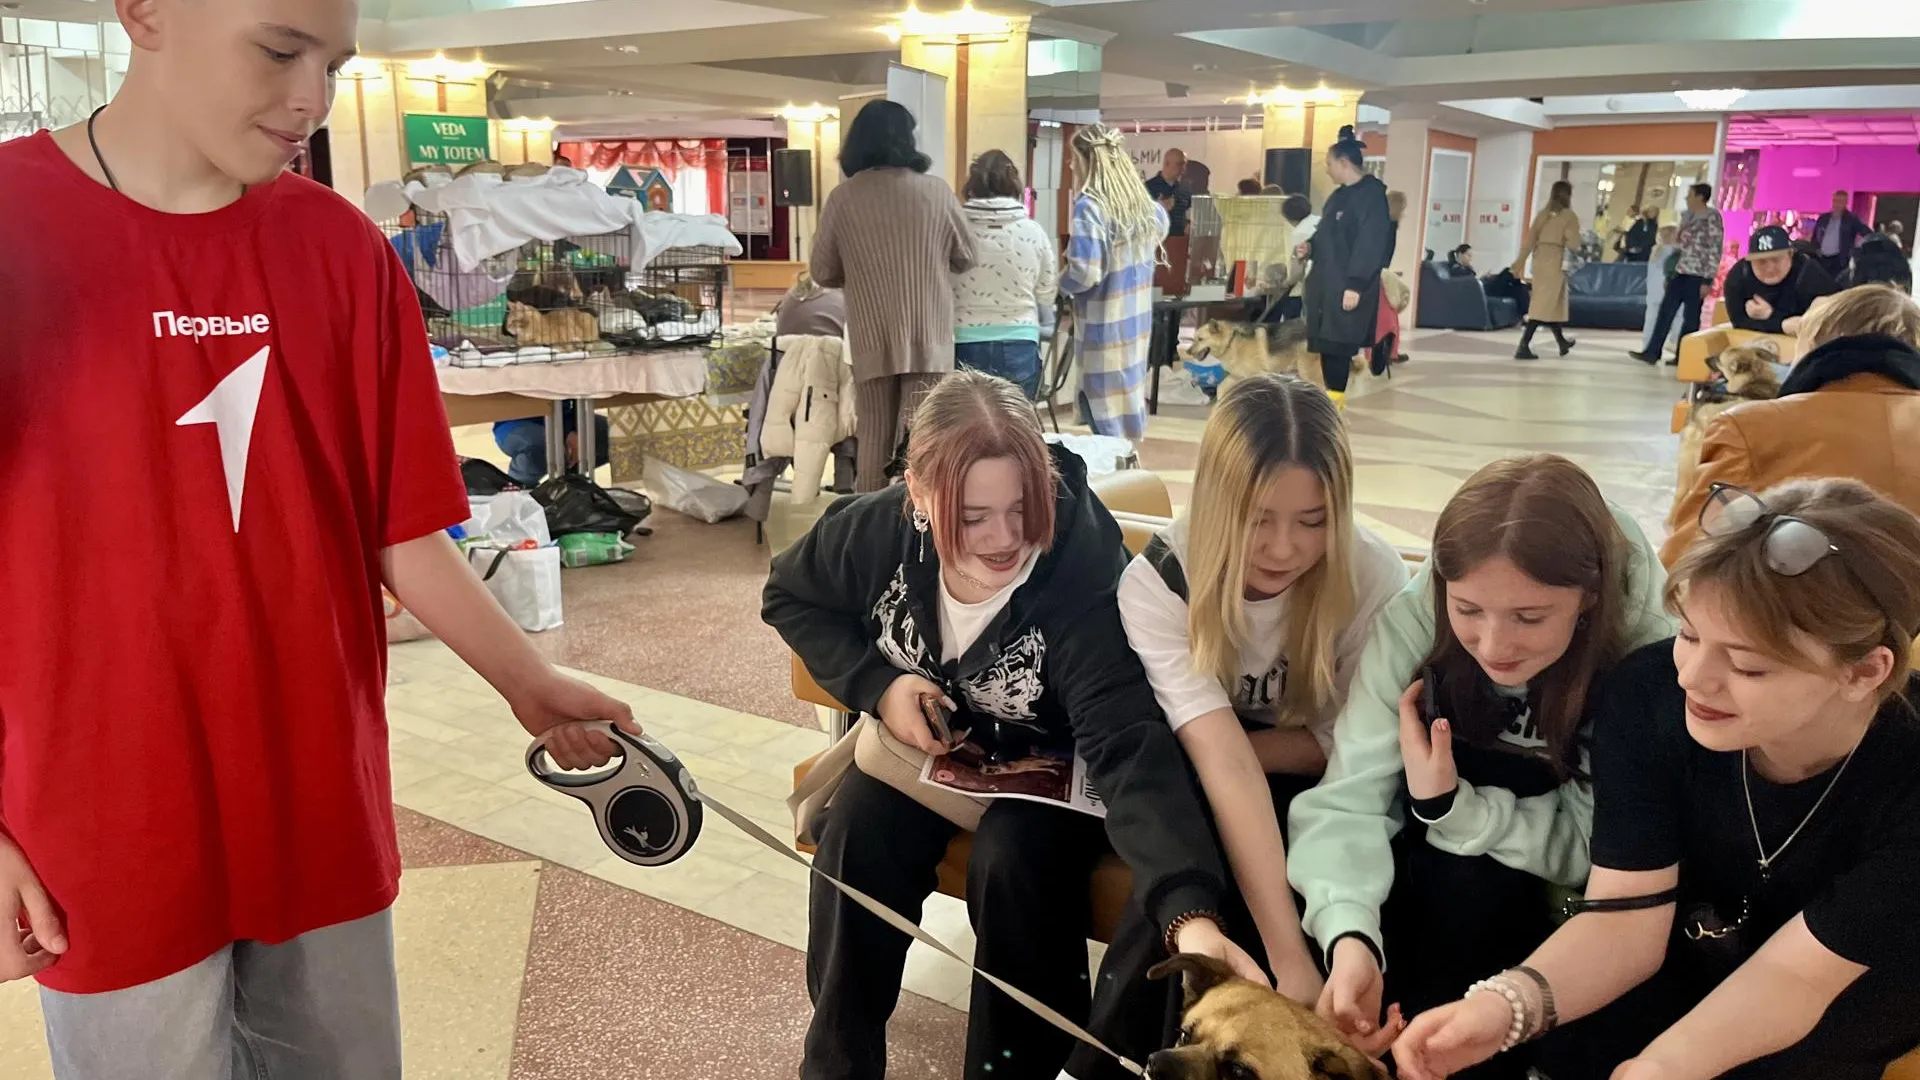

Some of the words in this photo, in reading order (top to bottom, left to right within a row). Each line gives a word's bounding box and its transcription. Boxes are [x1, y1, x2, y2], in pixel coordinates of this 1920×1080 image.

[432, 121, 467, 136] VEDA
[419, 145, 439, 160] MY
[441, 145, 486, 161] TOTEM
[1758, 235, 1773, 250] NY
[152, 310, 270, 344] Первые
